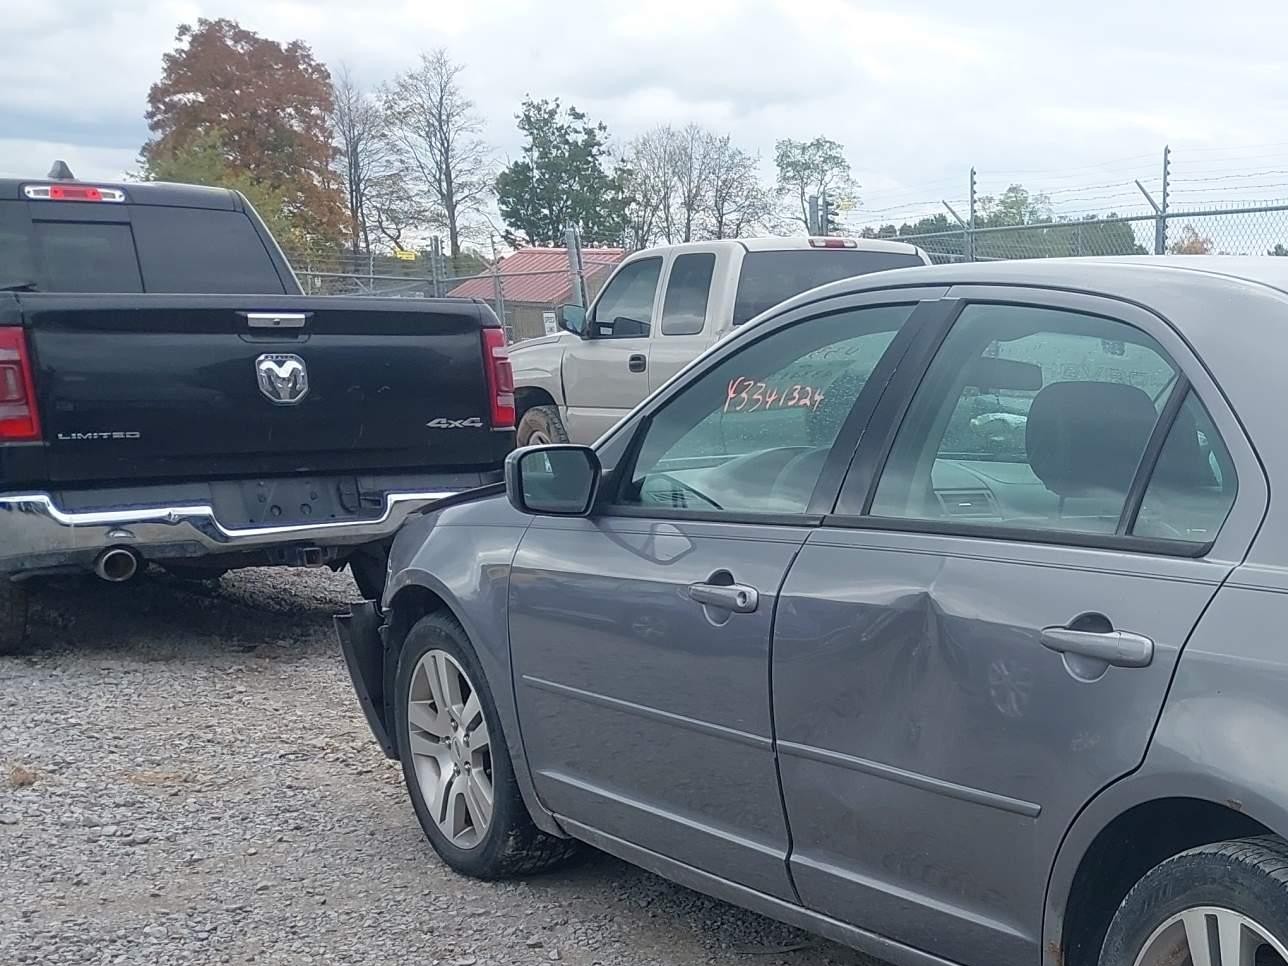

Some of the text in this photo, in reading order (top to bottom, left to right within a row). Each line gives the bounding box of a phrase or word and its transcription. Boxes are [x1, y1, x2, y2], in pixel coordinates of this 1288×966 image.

[724, 376, 825, 413] 43341324
[426, 417, 483, 429] 4x4
[57, 431, 141, 440] LIMITED
